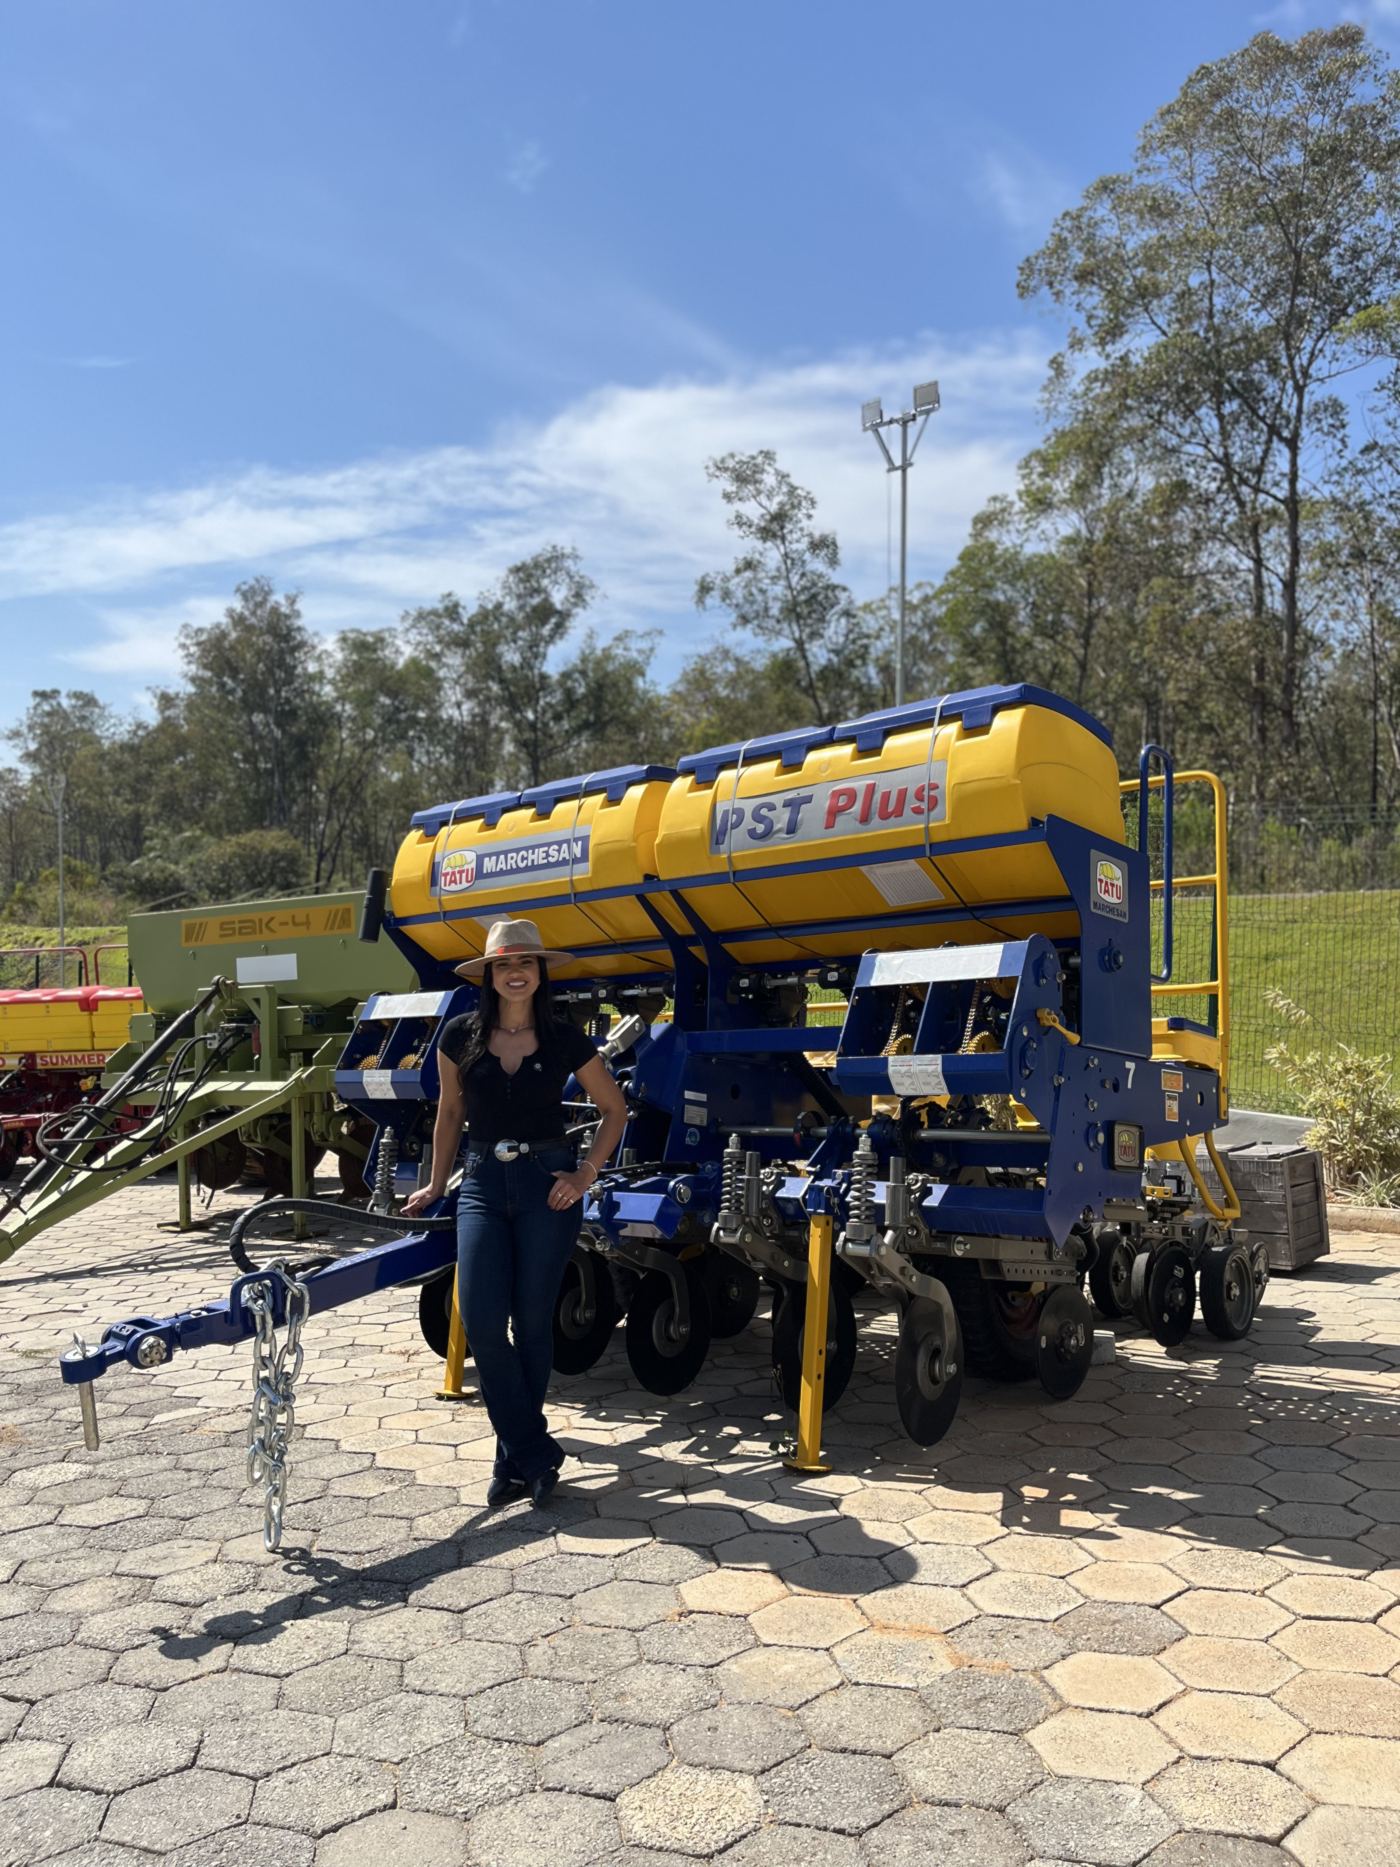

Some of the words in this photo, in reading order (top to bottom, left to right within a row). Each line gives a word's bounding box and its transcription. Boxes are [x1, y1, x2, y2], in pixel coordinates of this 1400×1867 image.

[715, 793, 814, 846] PST
[824, 780, 940, 830] Plus
[483, 840, 582, 875] MARCHESAN
[441, 867, 475, 888] TATU
[1097, 878, 1122, 901] TATU
[1092, 901, 1127, 919] MARCHESAN
[40, 1053, 106, 1067] SUMMER
[1125, 1061, 1136, 1089] 7
